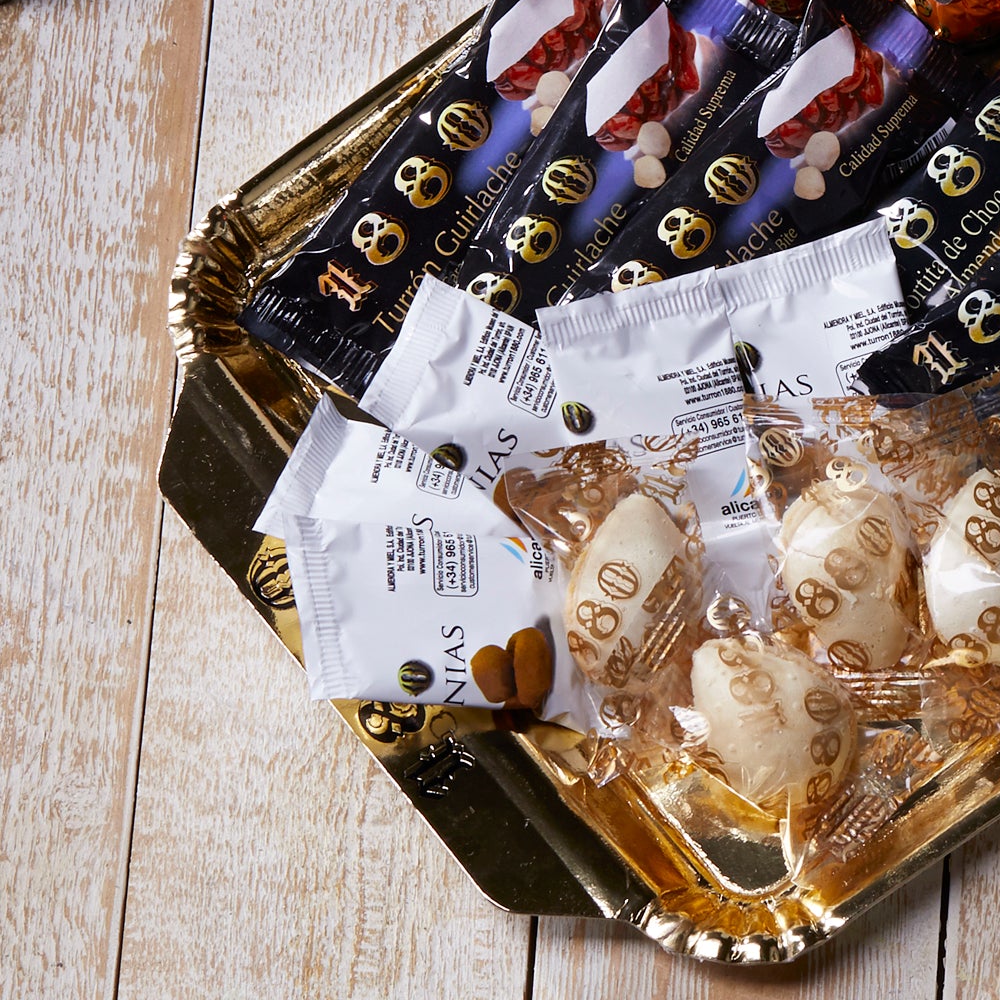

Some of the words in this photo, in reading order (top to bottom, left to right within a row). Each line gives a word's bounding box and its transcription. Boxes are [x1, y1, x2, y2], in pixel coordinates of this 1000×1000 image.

[674, 118, 708, 164] Calidad
[698, 68, 738, 121] Suprema
[837, 132, 882, 178] Calidad
[876, 93, 919, 141] Suprema
[317, 99, 494, 312] 1880
[434, 150, 523, 257] Guirlache
[775, 226, 799, 253] Bite
[943, 236, 968, 261] de
[546, 202, 628, 308] Guirlache
[496, 327, 525, 384] www.turron1880.com
[839, 359, 861, 371] Servicio
[519, 382, 537, 406] (+34)
[528, 365, 542, 383] 965
[674, 414, 696, 426] Servicio
[695, 406, 725, 421] Consumidor
[710, 415, 730, 429] 965
[429, 470, 444, 491] (+34)
[434, 538, 442, 569] Consumidor
[444, 539, 455, 557] 965
[445, 561, 458, 588] (+34)
